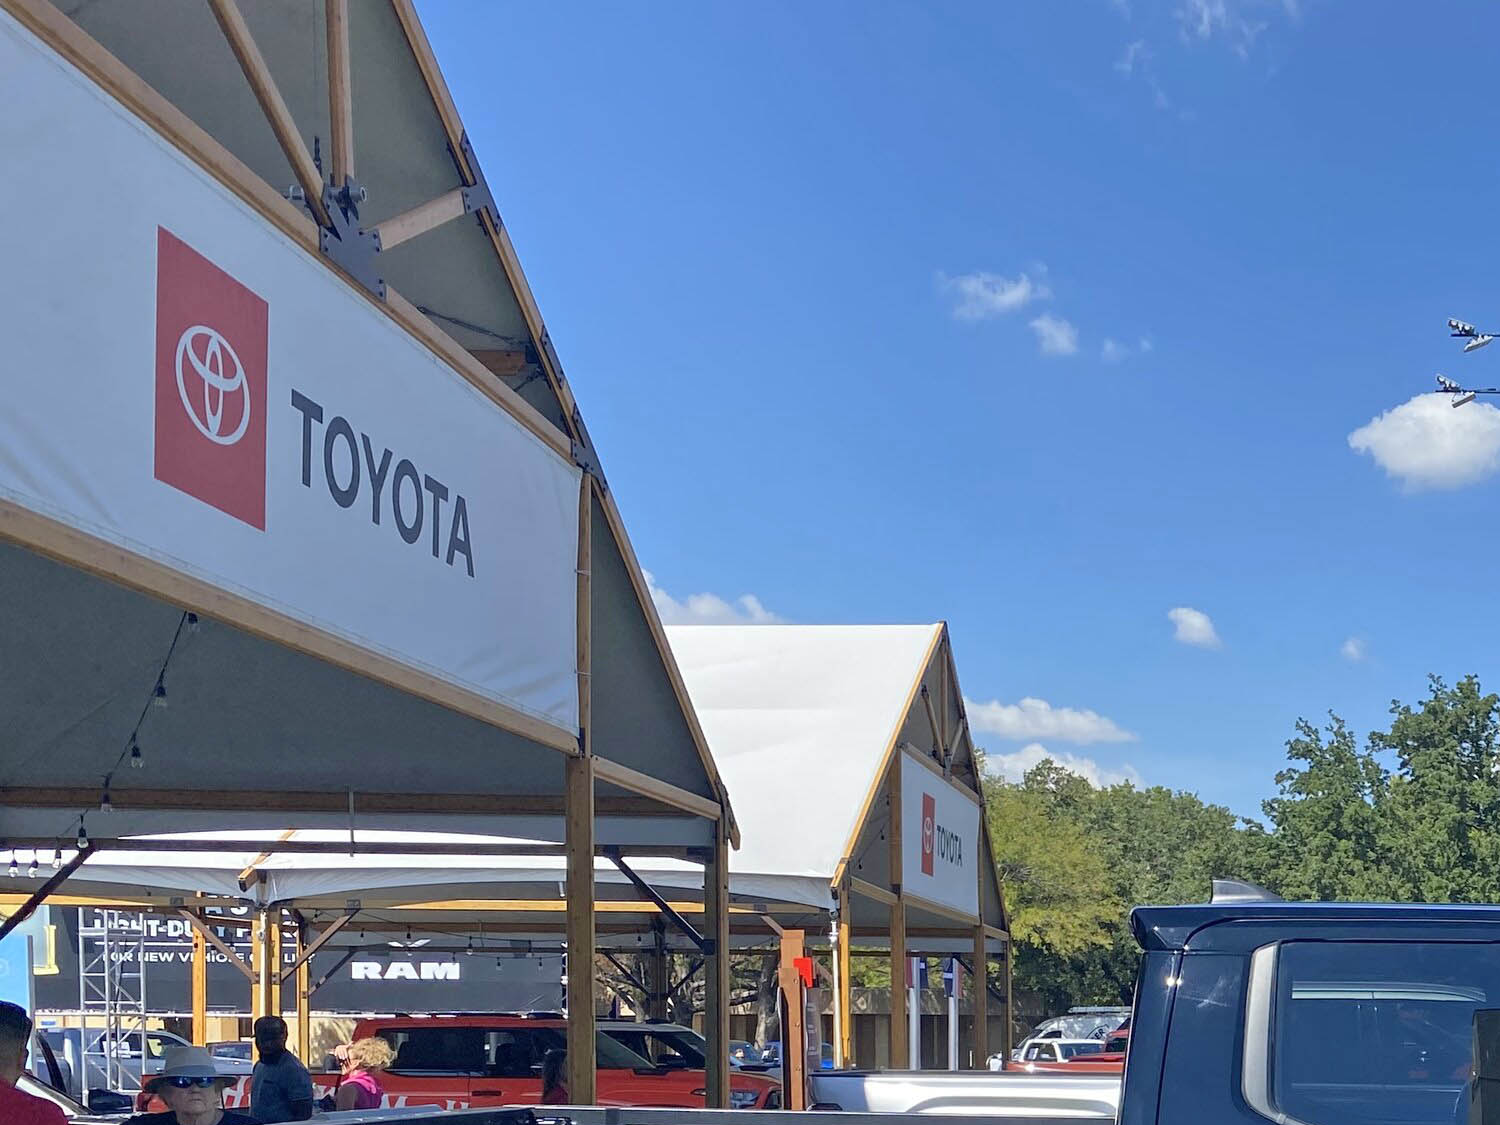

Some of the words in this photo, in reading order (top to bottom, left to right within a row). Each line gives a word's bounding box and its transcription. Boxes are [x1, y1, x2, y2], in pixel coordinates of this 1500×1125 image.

[290, 388, 475, 578] TOYOTA
[937, 824, 963, 868] TOYOTA
[351, 961, 461, 980] RAM
